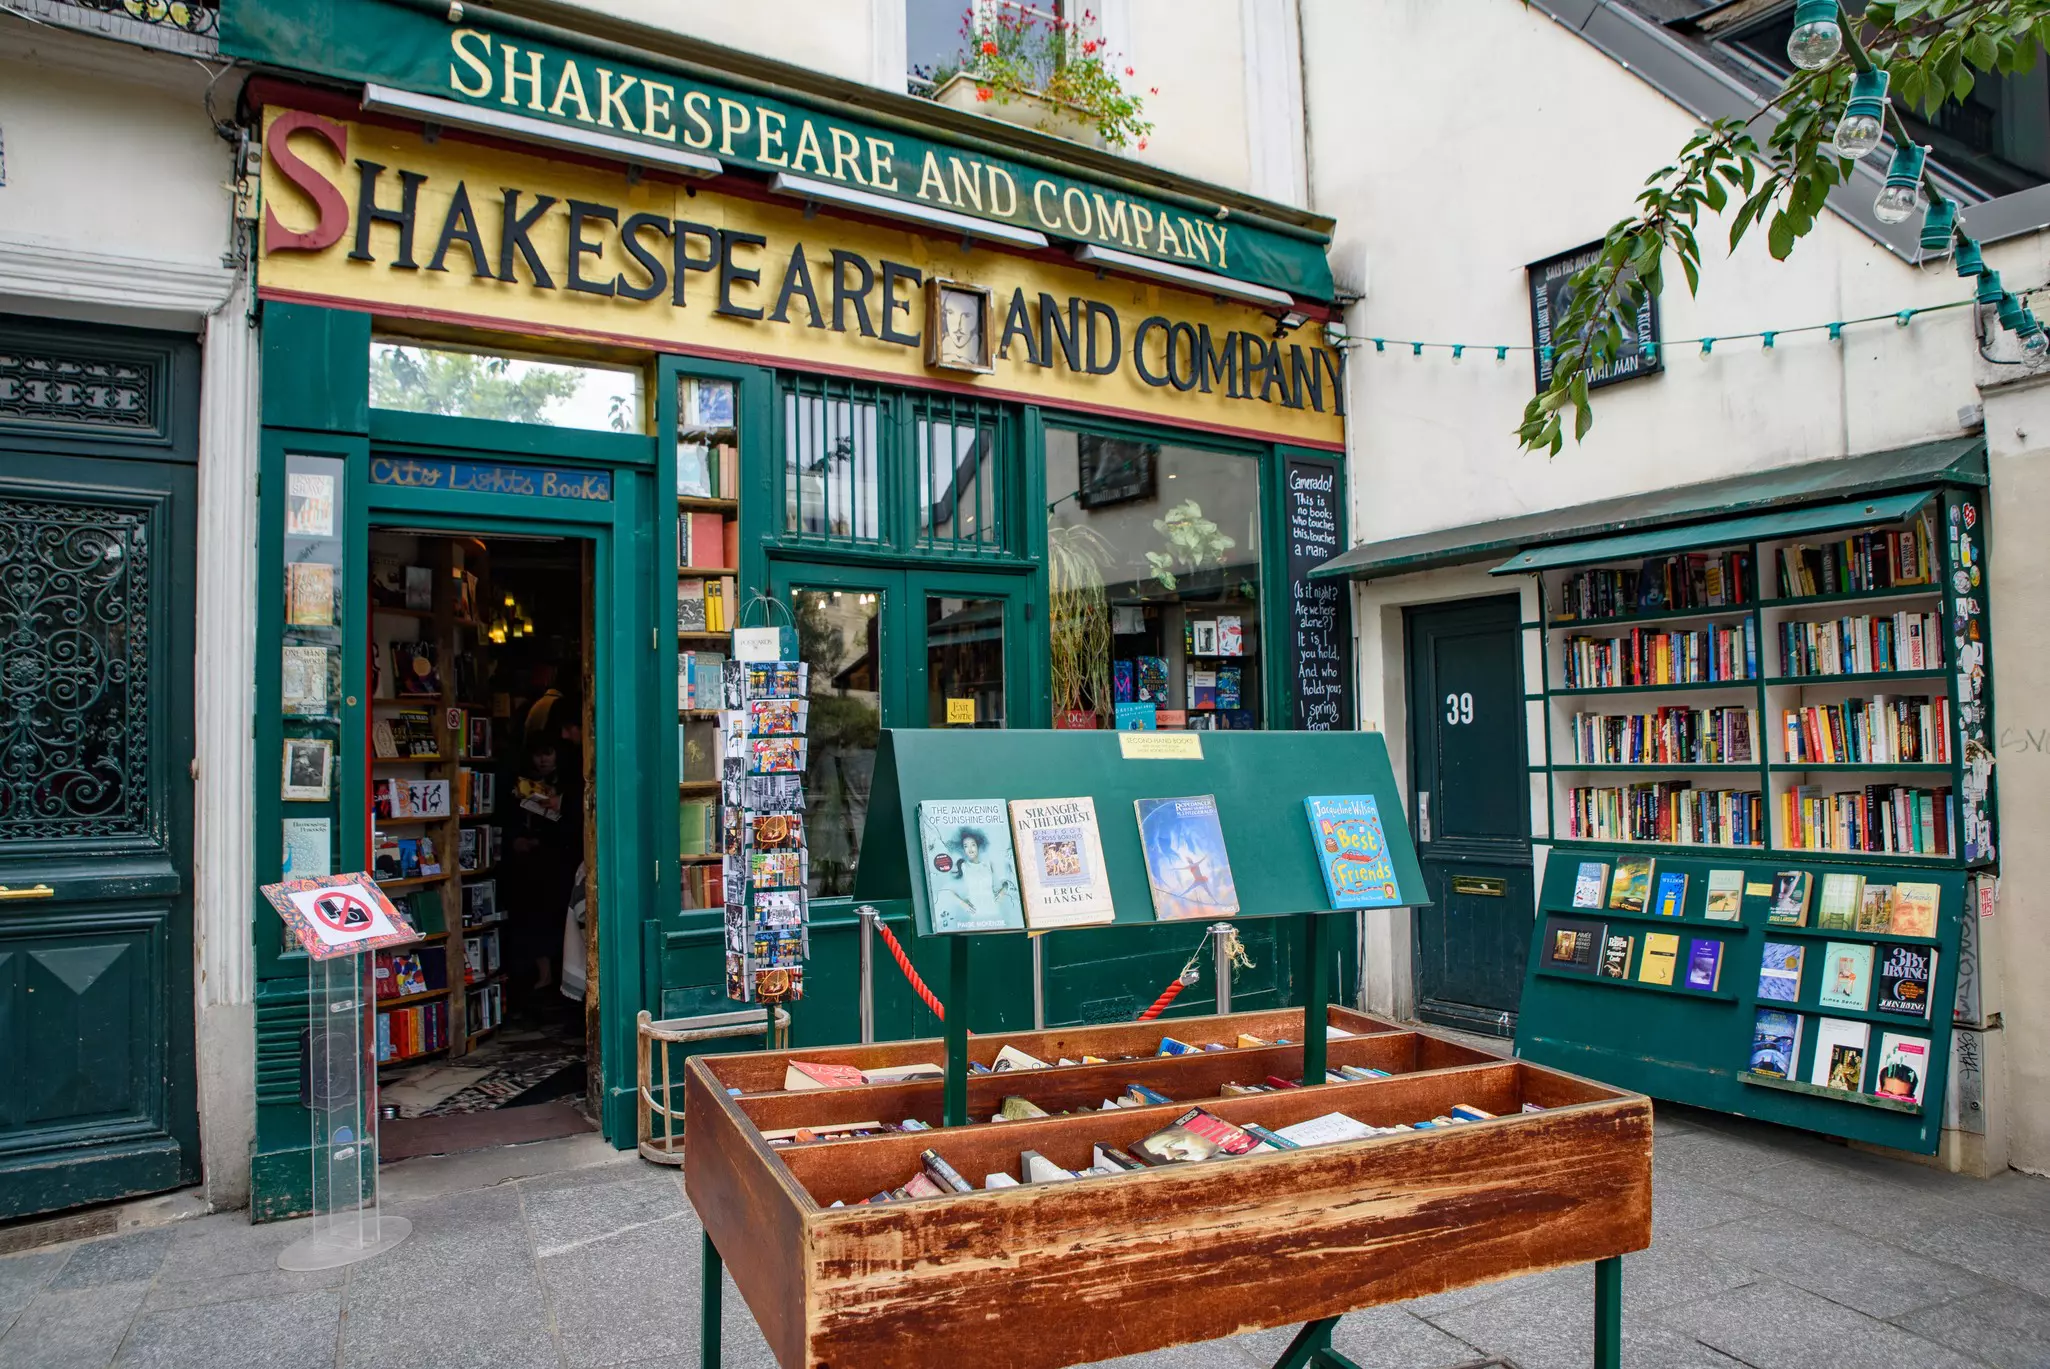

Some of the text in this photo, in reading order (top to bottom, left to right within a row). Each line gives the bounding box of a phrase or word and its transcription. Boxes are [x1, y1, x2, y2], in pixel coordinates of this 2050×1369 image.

[449, 28, 1229, 268] SHAKESPEARE AND COMPANY
[265, 110, 1346, 416] SHAKESPEARE AND COMPANY
[370, 458, 442, 486] City
[449, 465, 534, 495] Lights
[1289, 470, 1333, 493] Camerado!
[1293, 492, 1326, 507] This is
[1297, 507, 1333, 520] no book;
[1308, 516, 1335, 532] touches
[1309, 530, 1336, 545] touches
[1294, 544, 1328, 558] a man;
[1305, 581, 1312, 599] it
[1314, 582, 1339, 604] night?
[1295, 601, 1336, 616] Are we here
[1300, 617, 1334, 632] alone?)
[1298, 630, 1328, 647] It is I
[1300, 644, 1340, 664] you hold,
[1298, 663, 1338, 679] And who
[1303, 678, 1325, 696] holds
[949, 710, 973, 721] Sortie
[952, 701, 969, 714] Exit
[1301, 701, 1340, 723] I spring
[1446, 692, 1474, 725] 39
[1155, 713, 1183, 723] ABRINA
[1307, 717, 1330, 731] from
[931, 805, 999, 815] THE AWAKENING
[1025, 803, 1080, 818] STRANGER
[1313, 800, 1376, 818] Jacqueline Wilson
[929, 814, 1005, 825] OF SUNSHINE GIRL
[1018, 812, 1091, 830] IN THE FOREST
[1058, 833, 1084, 841] BORNEO
[1336, 827, 1378, 850] Best
[1337, 861, 1392, 886] Friends
[1043, 892, 1093, 905] HANSEN
[1053, 886, 1082, 896] ERIC
[1891, 947, 1928, 969] 3 BY
[1882, 961, 1928, 980] IRVING
[1879, 999, 1925, 1010] JOHN IRVING
